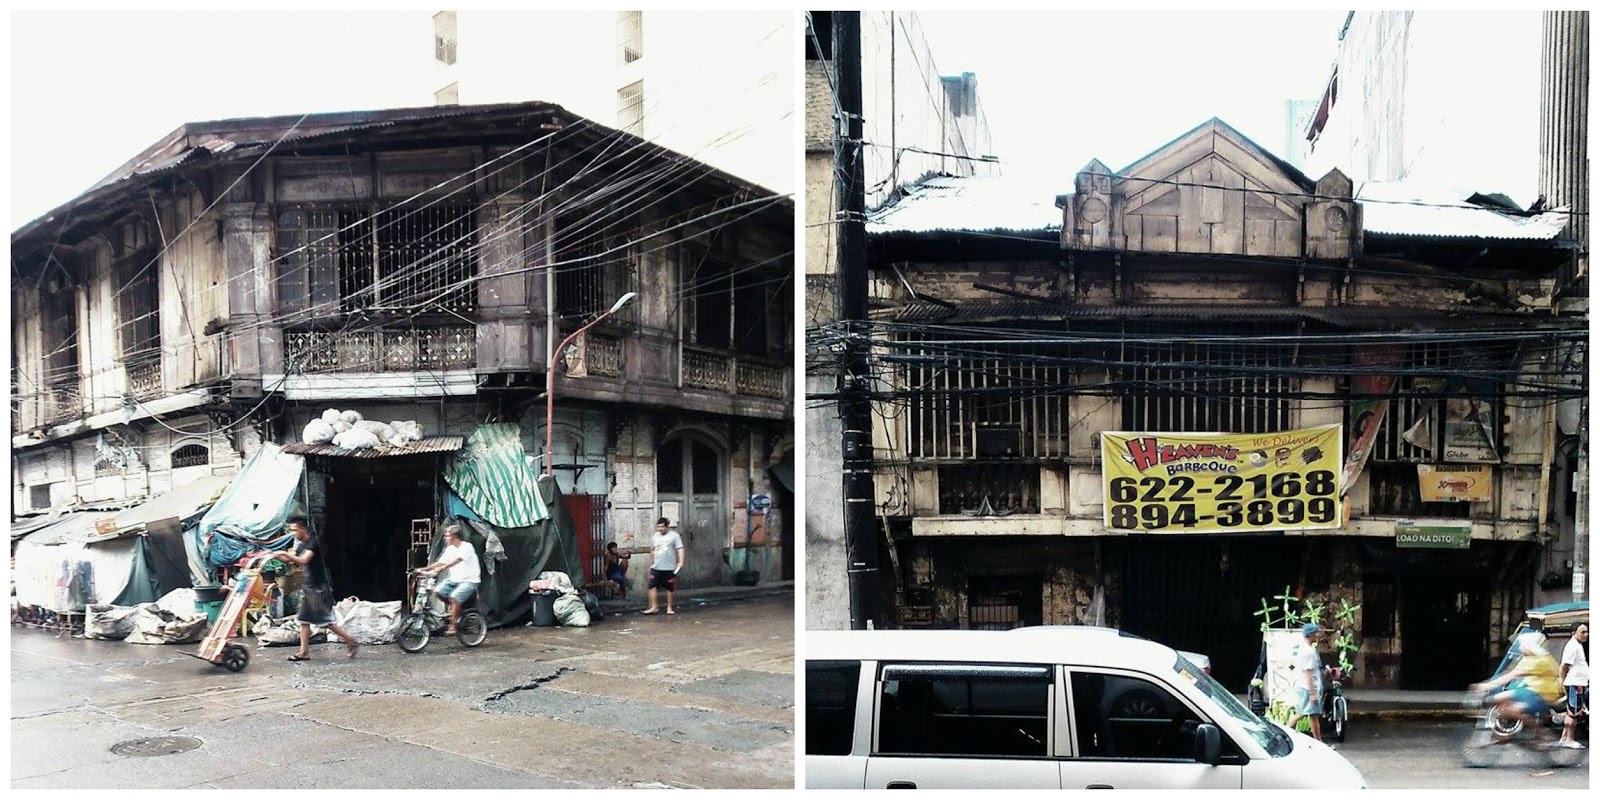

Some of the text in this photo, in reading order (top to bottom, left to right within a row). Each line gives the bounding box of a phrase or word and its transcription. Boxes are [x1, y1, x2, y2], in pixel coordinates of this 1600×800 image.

[1253, 438, 1271, 447] We
[1110, 470, 1335, 503] 622-2168
[1111, 498, 1335, 529] 894-3899
[1396, 534, 1419, 543] LOAD
[1419, 534, 1432, 543] NA
